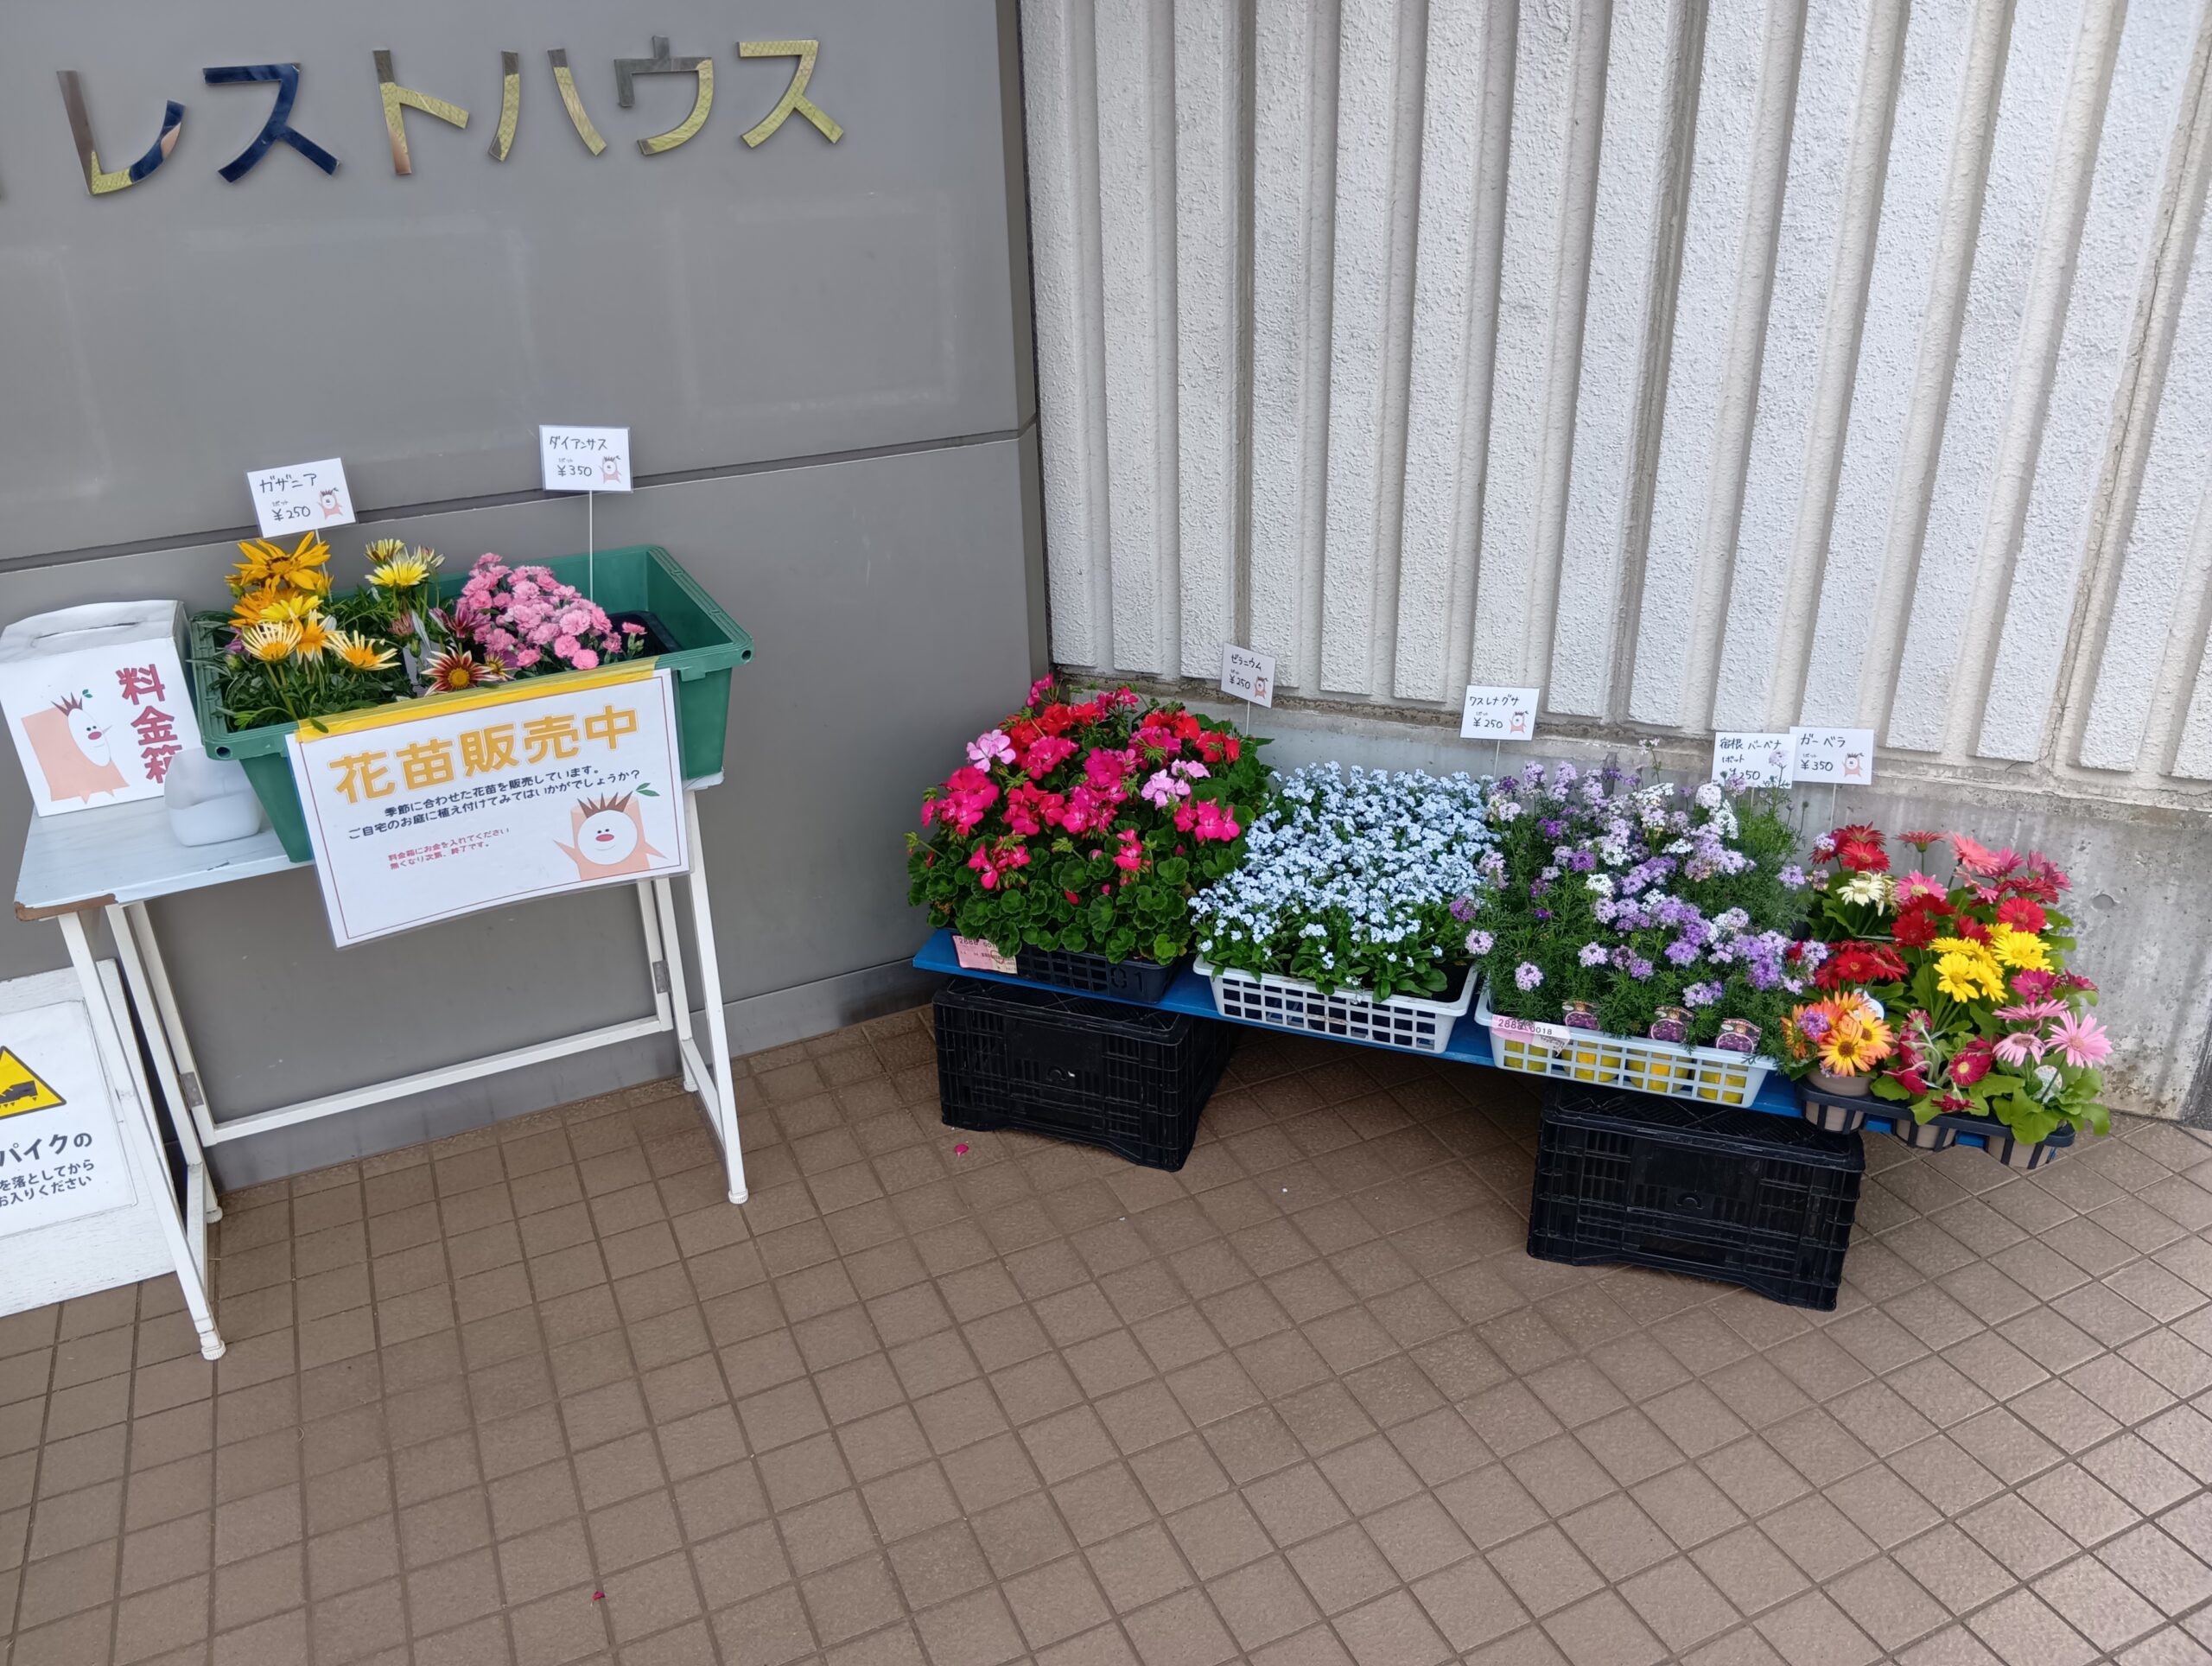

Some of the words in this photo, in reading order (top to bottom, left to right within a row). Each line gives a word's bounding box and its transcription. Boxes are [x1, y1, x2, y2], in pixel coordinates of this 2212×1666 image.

[56, 35, 845, 196] レストハウス
[549, 435, 608, 451] ダイアンサス
[556, 464, 593, 478] ¥350
[258, 473, 317, 493] ガザニア
[270, 506, 311, 522] ¥250
[1230, 653, 1262, 671] ゼラニウム
[1229, 674, 1251, 690] ¥250
[1469, 693, 1520, 707] ワスレナグサ
[1472, 717, 1503, 729] ¥250
[1800, 733, 1846, 748] ガーベラ
[327, 703, 640, 805] 花苗販売中
[1800, 759, 1834, 772] ¥350
[384, 765, 600, 818] 季節に合わせた花苗を販売しています。
